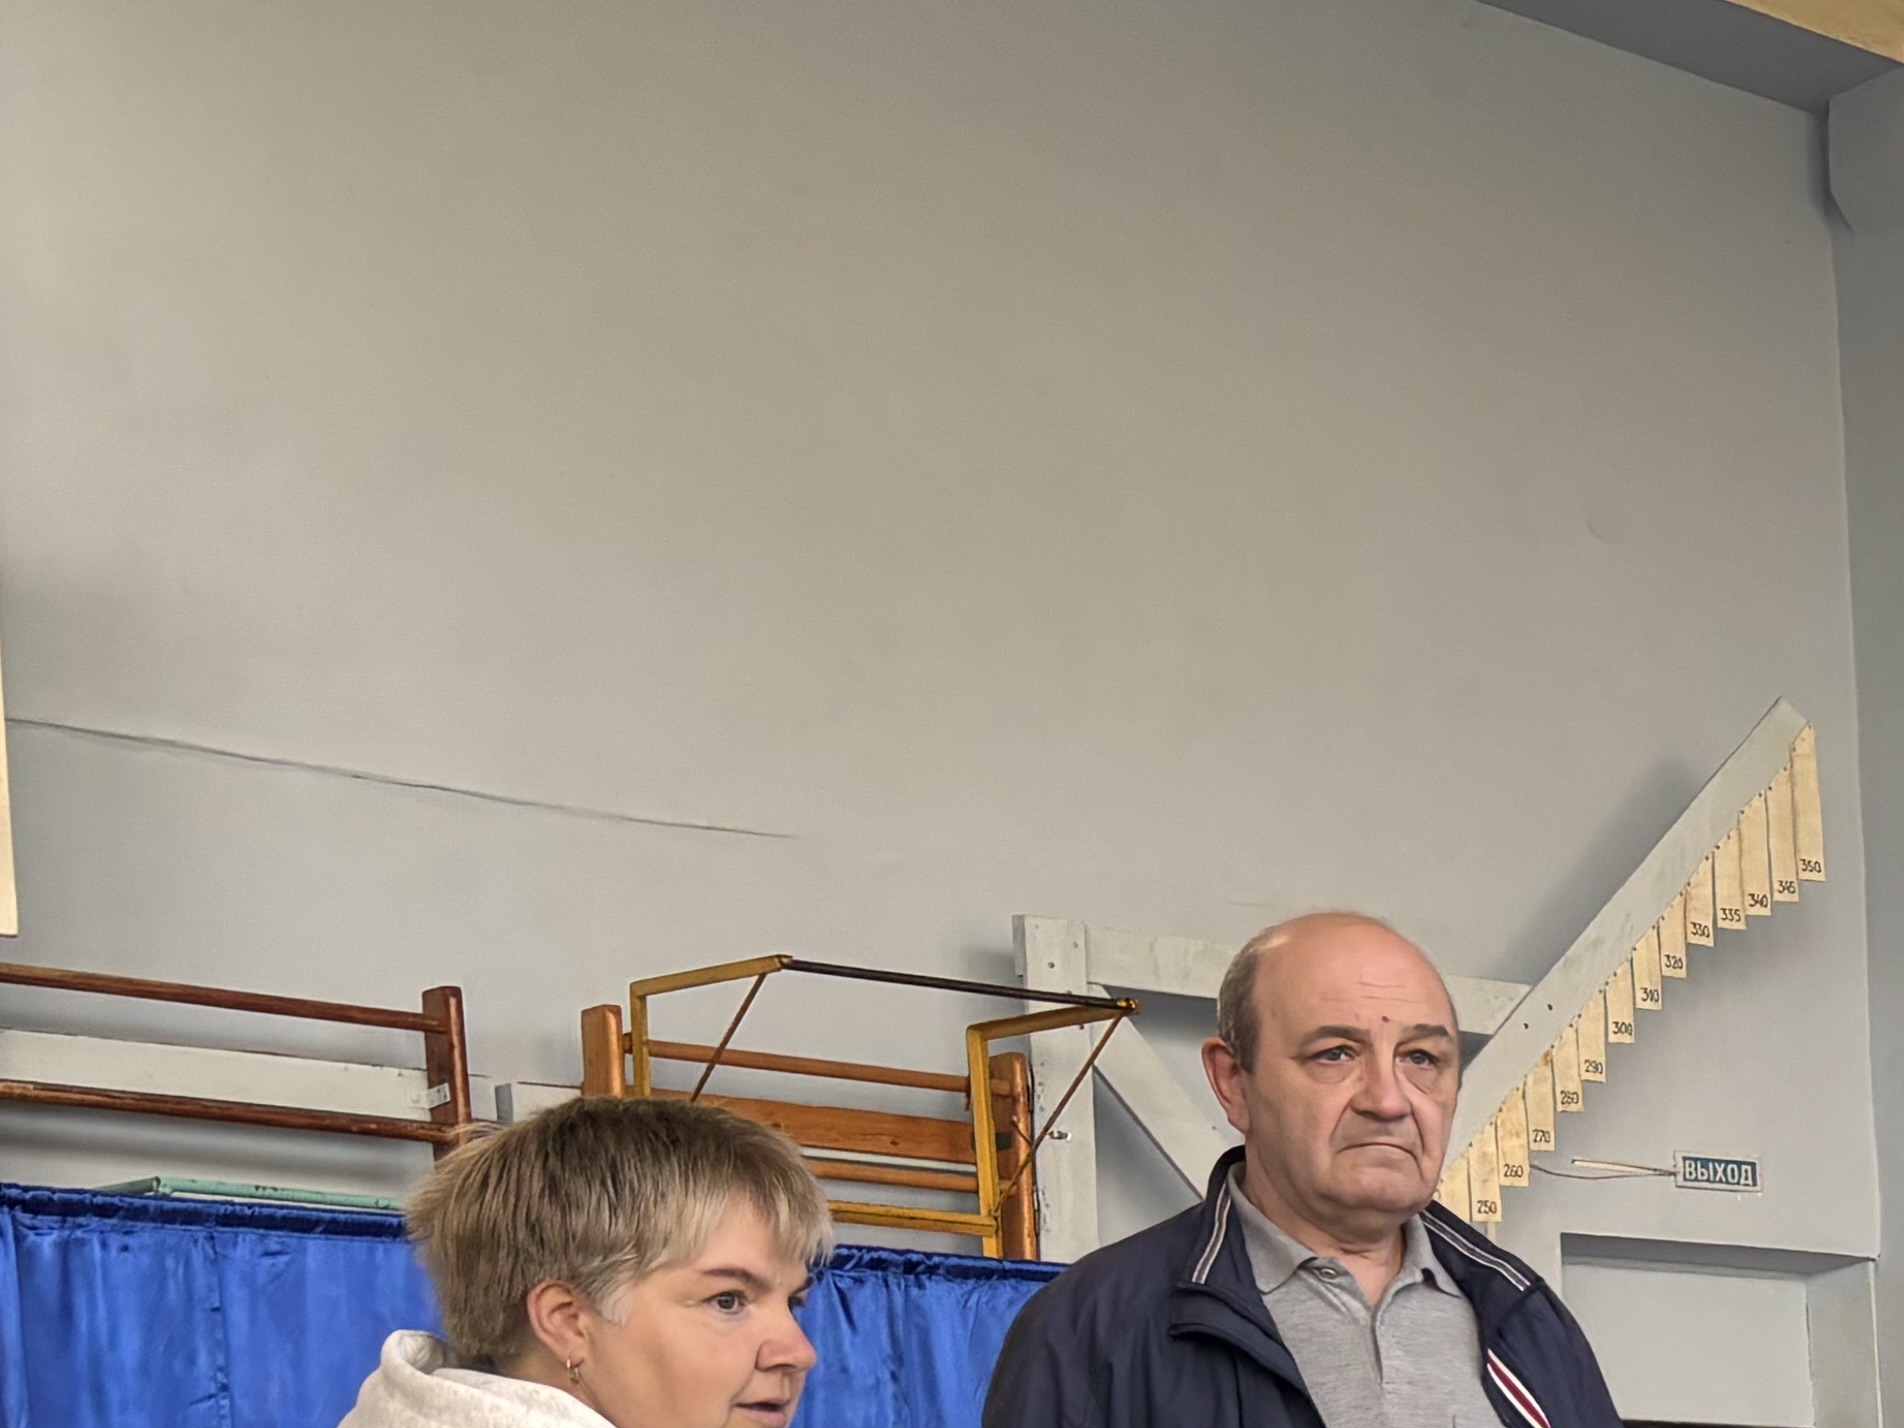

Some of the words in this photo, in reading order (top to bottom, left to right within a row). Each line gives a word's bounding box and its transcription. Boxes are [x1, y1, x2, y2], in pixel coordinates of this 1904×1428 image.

[1800, 858, 1822, 874] 350
[1748, 893, 1769, 909] 340
[1719, 907, 1742, 923] 335
[1690, 922, 1711, 939] 330
[1664, 954, 1684, 970] 320
[1612, 1021, 1633, 1037] 300
[1584, 1059, 1604, 1075] 290
[1532, 1128, 1551, 1144] 270
[1503, 1163, 1524, 1179] 260
[1684, 1159, 1753, 1187] ВЫХОД
[1476, 1200, 1498, 1215] 250
